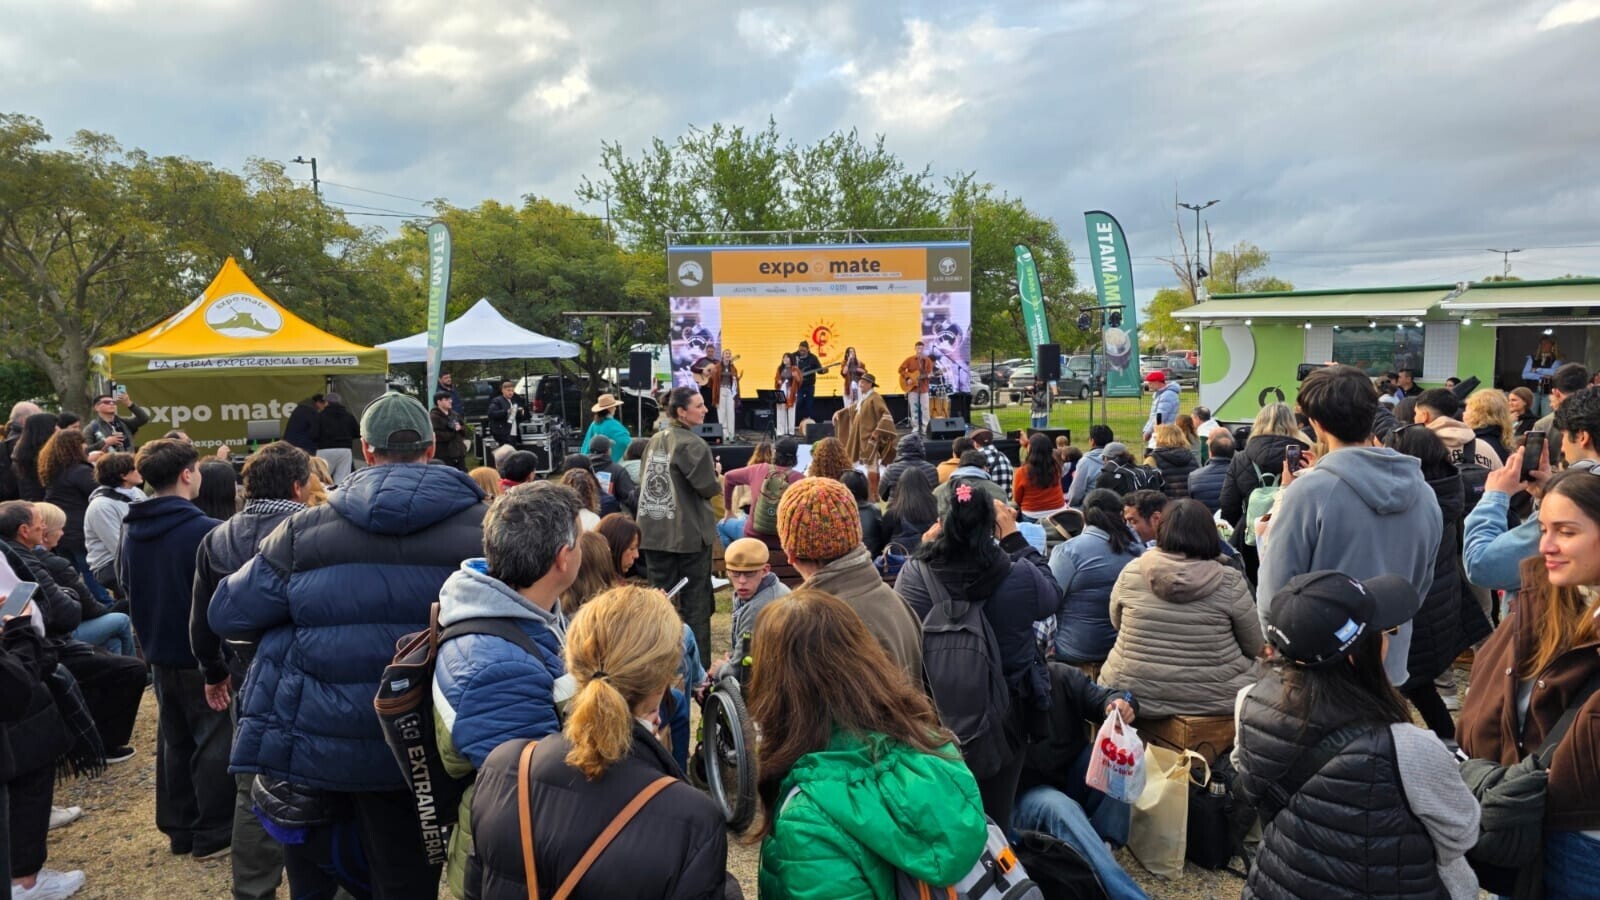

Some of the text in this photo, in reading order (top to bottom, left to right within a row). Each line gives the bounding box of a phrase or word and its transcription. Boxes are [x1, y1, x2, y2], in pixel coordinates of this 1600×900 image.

[759, 258, 881, 278] expo mate
[216, 296, 267, 309] expo mate
[154, 356, 355, 369] LA FERIA EXPERIENCIAL DEL MATE
[221, 399, 298, 420] mate
